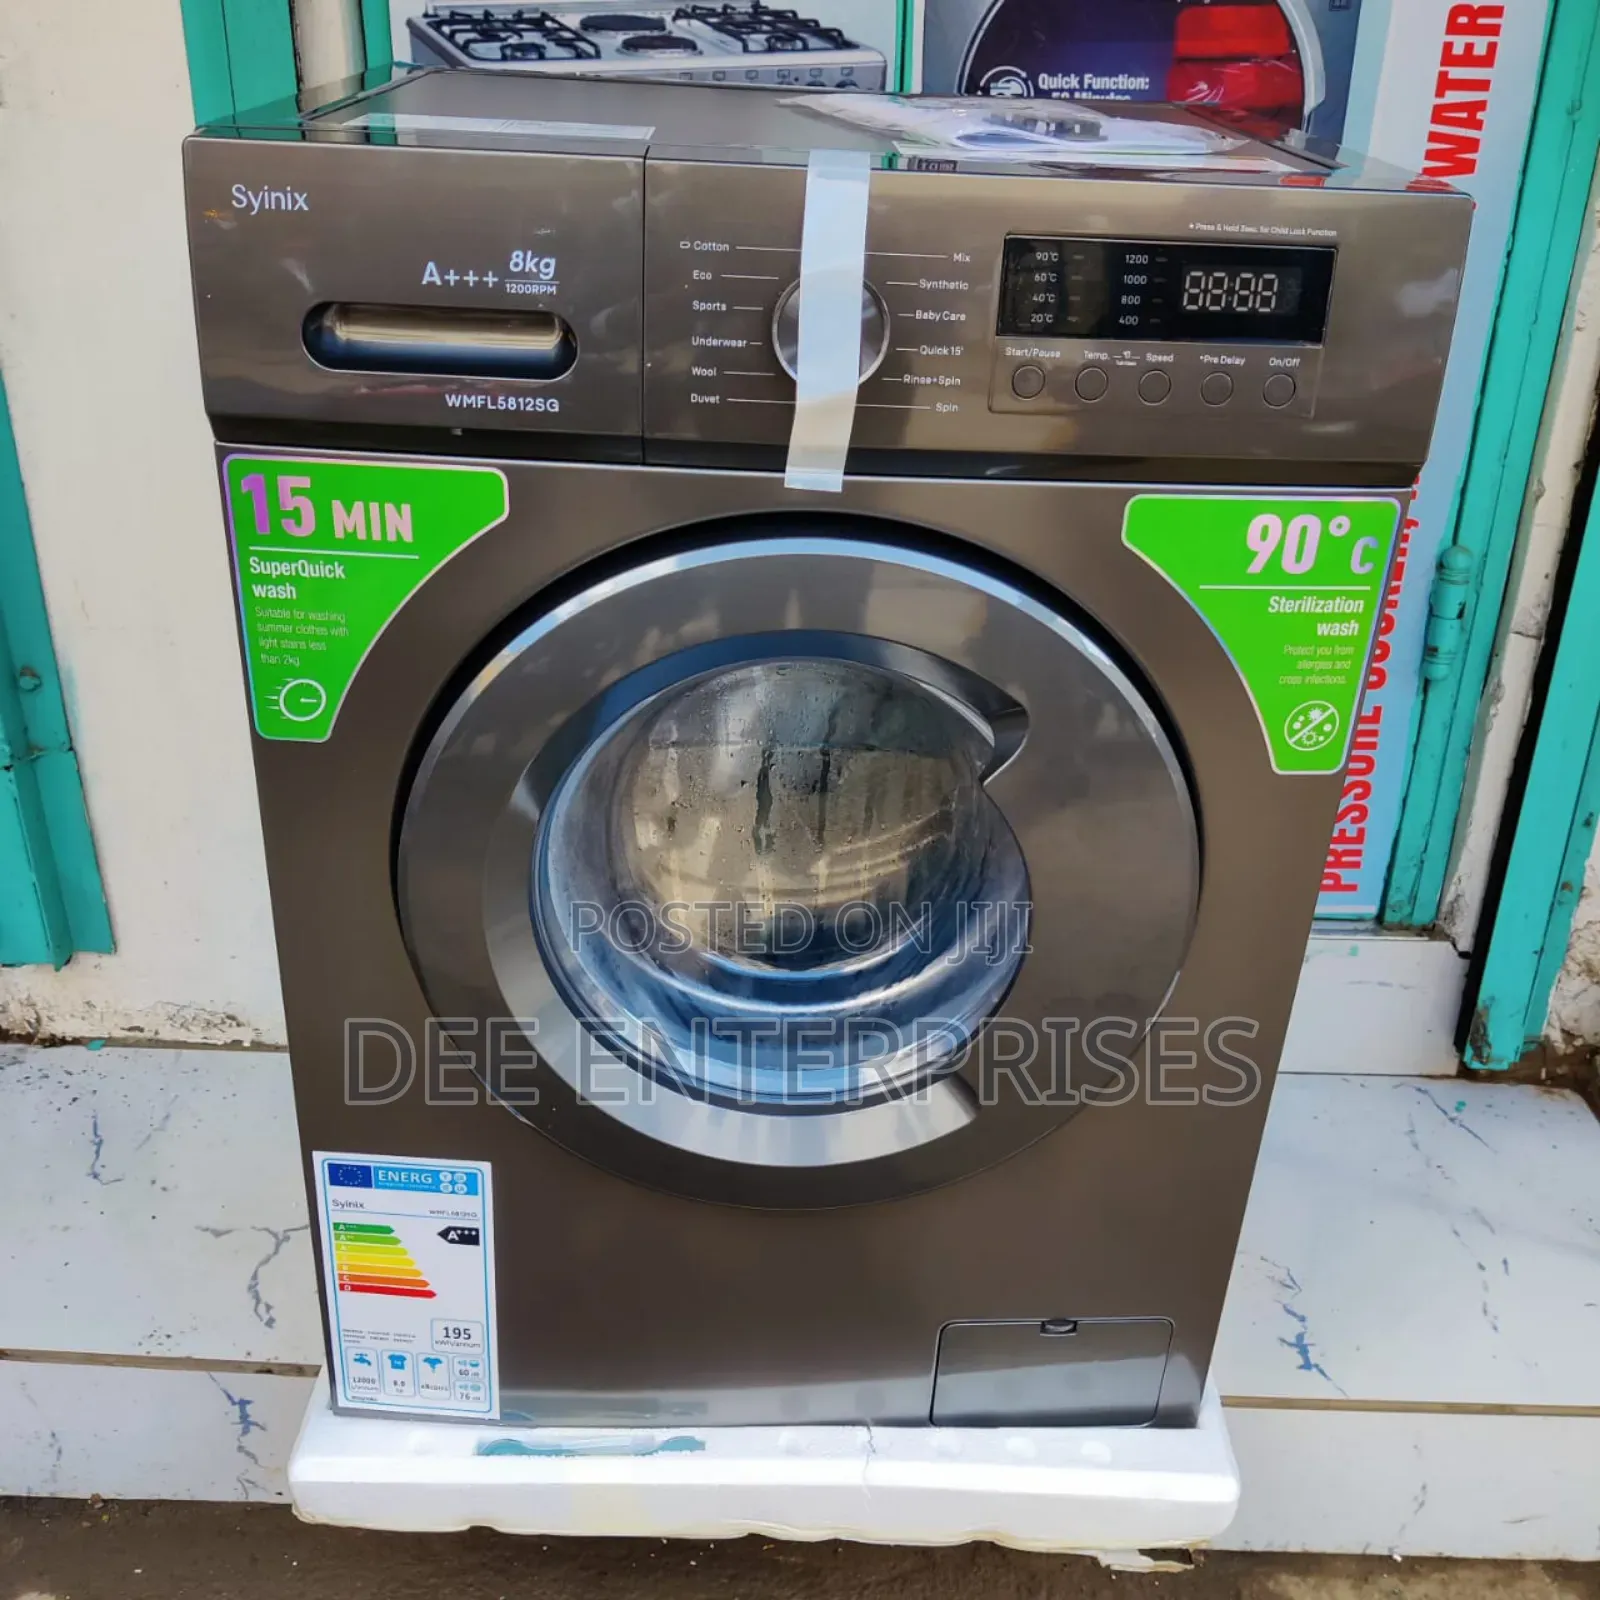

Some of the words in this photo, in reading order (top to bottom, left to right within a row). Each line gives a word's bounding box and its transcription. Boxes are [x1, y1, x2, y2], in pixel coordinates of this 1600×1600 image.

[1038, 73, 1080, 91] Quick
[1083, 73, 1149, 91] Function:
[1421, 3, 1505, 179] WATER
[231, 183, 309, 215] Syinix
[1307, 228, 1337, 237] Function
[693, 240, 730, 252] Cotton
[953, 252, 970, 262] Mix
[1035, 251, 1060, 263] 90°C
[1125, 254, 1149, 265] 1200
[509, 249, 557, 281] 8kg
[421, 260, 499, 288] A+++
[692, 269, 712, 281] Eco
[1034, 272, 1058, 283] 60°C
[1123, 274, 1148, 285] 1000
[504, 283, 557, 296] 1200RPM
[919, 279, 969, 291] Synthetic
[1032, 292, 1056, 303] 40°C
[1120, 295, 1142, 306] 800
[692, 300, 727, 313] Sports
[915, 309, 941, 323] Baby
[942, 310, 966, 321] Care
[1030, 312, 1054, 324] 20°C
[1118, 315, 1140, 326] 400
[691, 335, 748, 349] Underwear
[920, 344, 949, 356] Quick
[1004, 346, 1061, 358] Start/Pause
[1083, 350, 1110, 362] Temp.
[1145, 353, 1174, 364] Speed
[1220, 355, 1246, 367] Delay
[1268, 356, 1301, 368] On/Off
[690, 366, 717, 377] Wool
[444, 393, 560, 413] WMFL5812SG
[690, 393, 721, 404] Duvet
[935, 402, 960, 414] Spin
[240, 473, 317, 537] 15
[331, 499, 414, 543] MIN
[249, 556, 346, 580] SuperQuick
[251, 582, 298, 600] wash
[1267, 595, 1365, 615] Sterilization
[254, 606, 291, 620] Suitable
[294, 608, 306, 620] for
[308, 610, 347, 625] washing
[256, 623, 293, 635] summer
[295, 625, 329, 637] clothes
[330, 627, 350, 637] with
[1316, 620, 1360, 637] wash
[258, 636, 279, 650] light
[280, 638, 307, 650] stains
[308, 640, 328, 652] less
[1283, 644, 1315, 656] Protect
[1315, 646, 1333, 658] you
[1333, 645, 1356, 656] from
[260, 653, 281, 666] than
[283, 654, 301, 668] 2kg
[1334, 660, 1352, 671] and
[378, 1169, 433, 1183] ENERG
[447, 1229, 477, 1241] A+++
[443, 1325, 472, 1341] 195
[459, 1369, 470, 1377] 60
